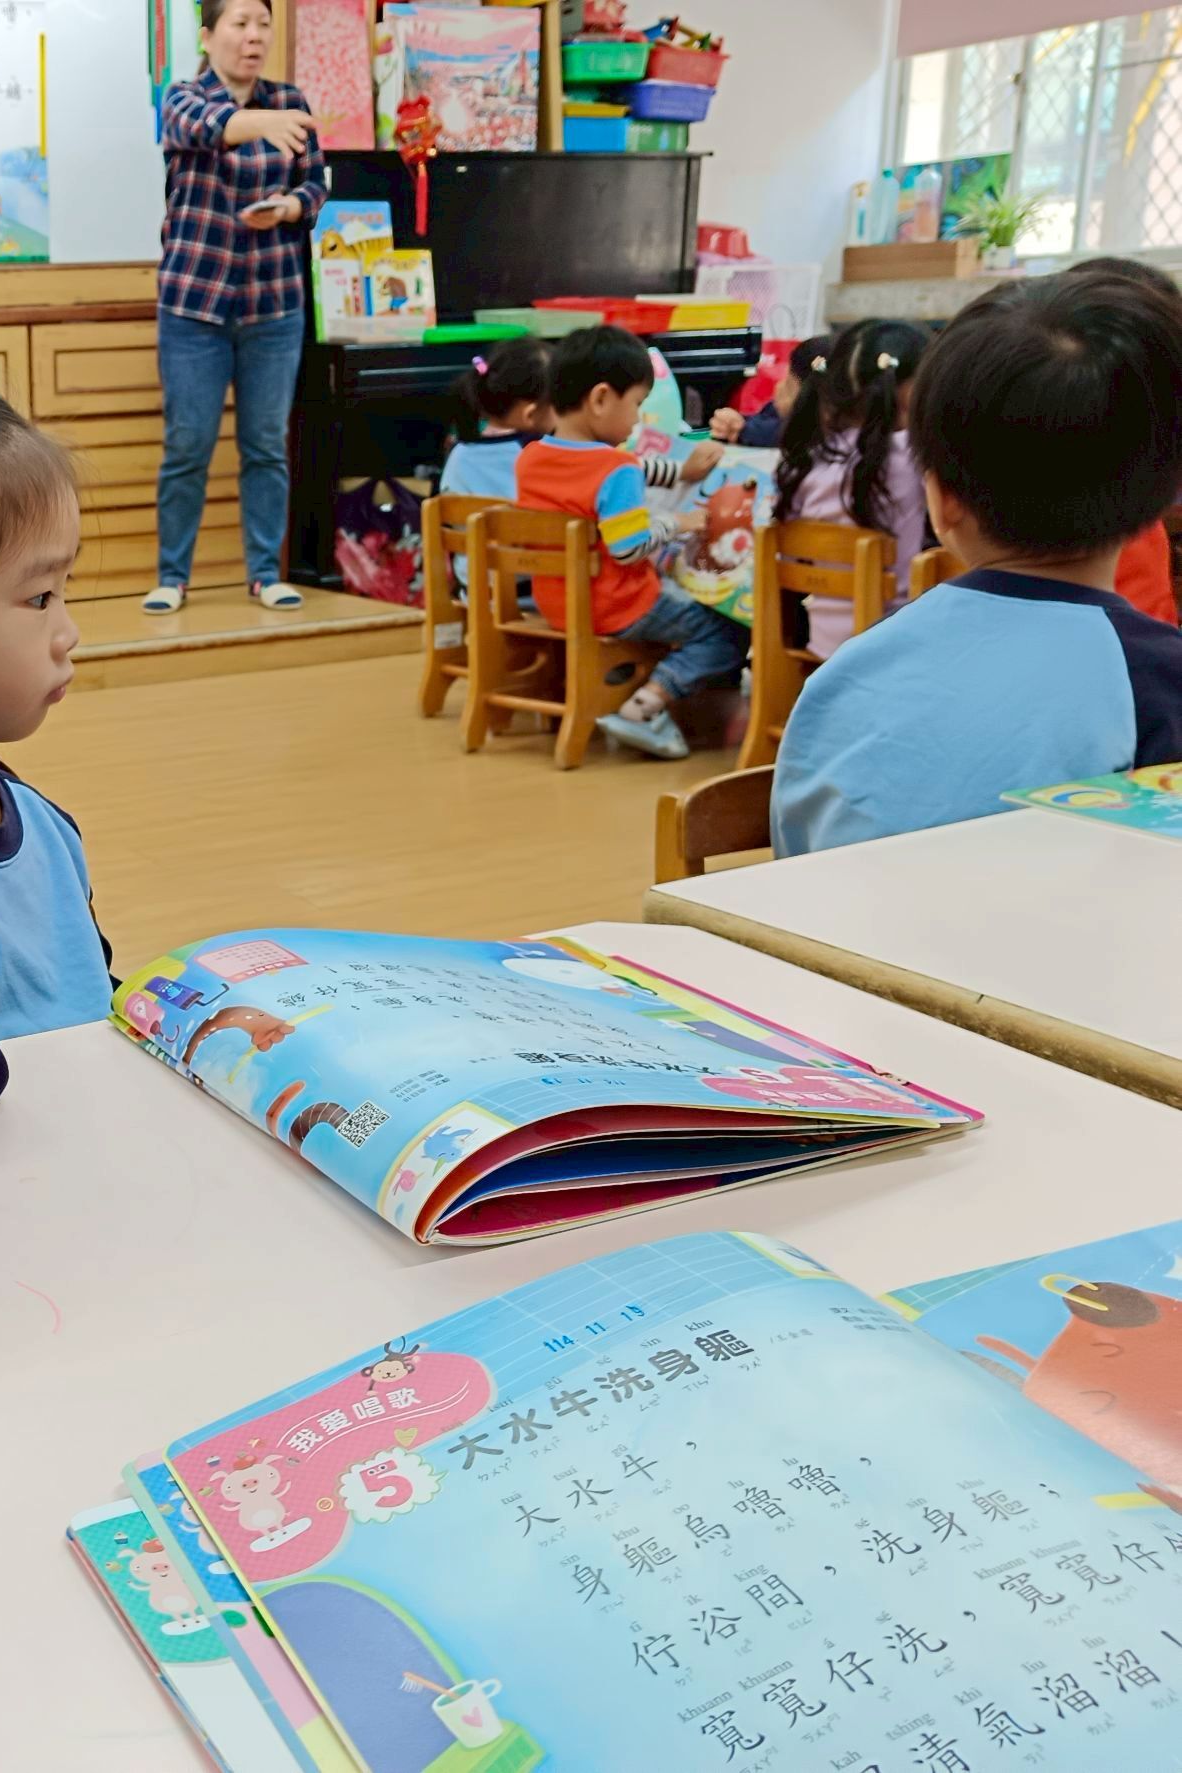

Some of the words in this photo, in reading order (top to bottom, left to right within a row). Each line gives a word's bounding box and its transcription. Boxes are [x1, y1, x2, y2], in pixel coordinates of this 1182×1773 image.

[639, 1337, 663, 1350] sin
[684, 1317, 715, 1334] khu
[286, 1386, 422, 1454] 我愛唱歌
[447, 1328, 755, 1471] 大水牛洗身軀
[359, 1459, 414, 1509] 5
[514, 1440, 698, 1539] 大水牛，
[572, 1456, 873, 1605] 身軀烏嚕嚕，
[611, 1525, 641, 1543] khu
[631, 1482, 1062, 1676] 佇浴間，洗身軀；
[732, 1564, 772, 1584] king
[676, 1690, 734, 1724] khuann
[737, 1660, 795, 1691] khuann
[972, 1557, 1027, 1581] khuann
[700, 1532, 1182, 1764] 寬寬仔洗，寬寬仔
[829, 1750, 864, 1772] kah
[885, 1712, 937, 1741] tshing
